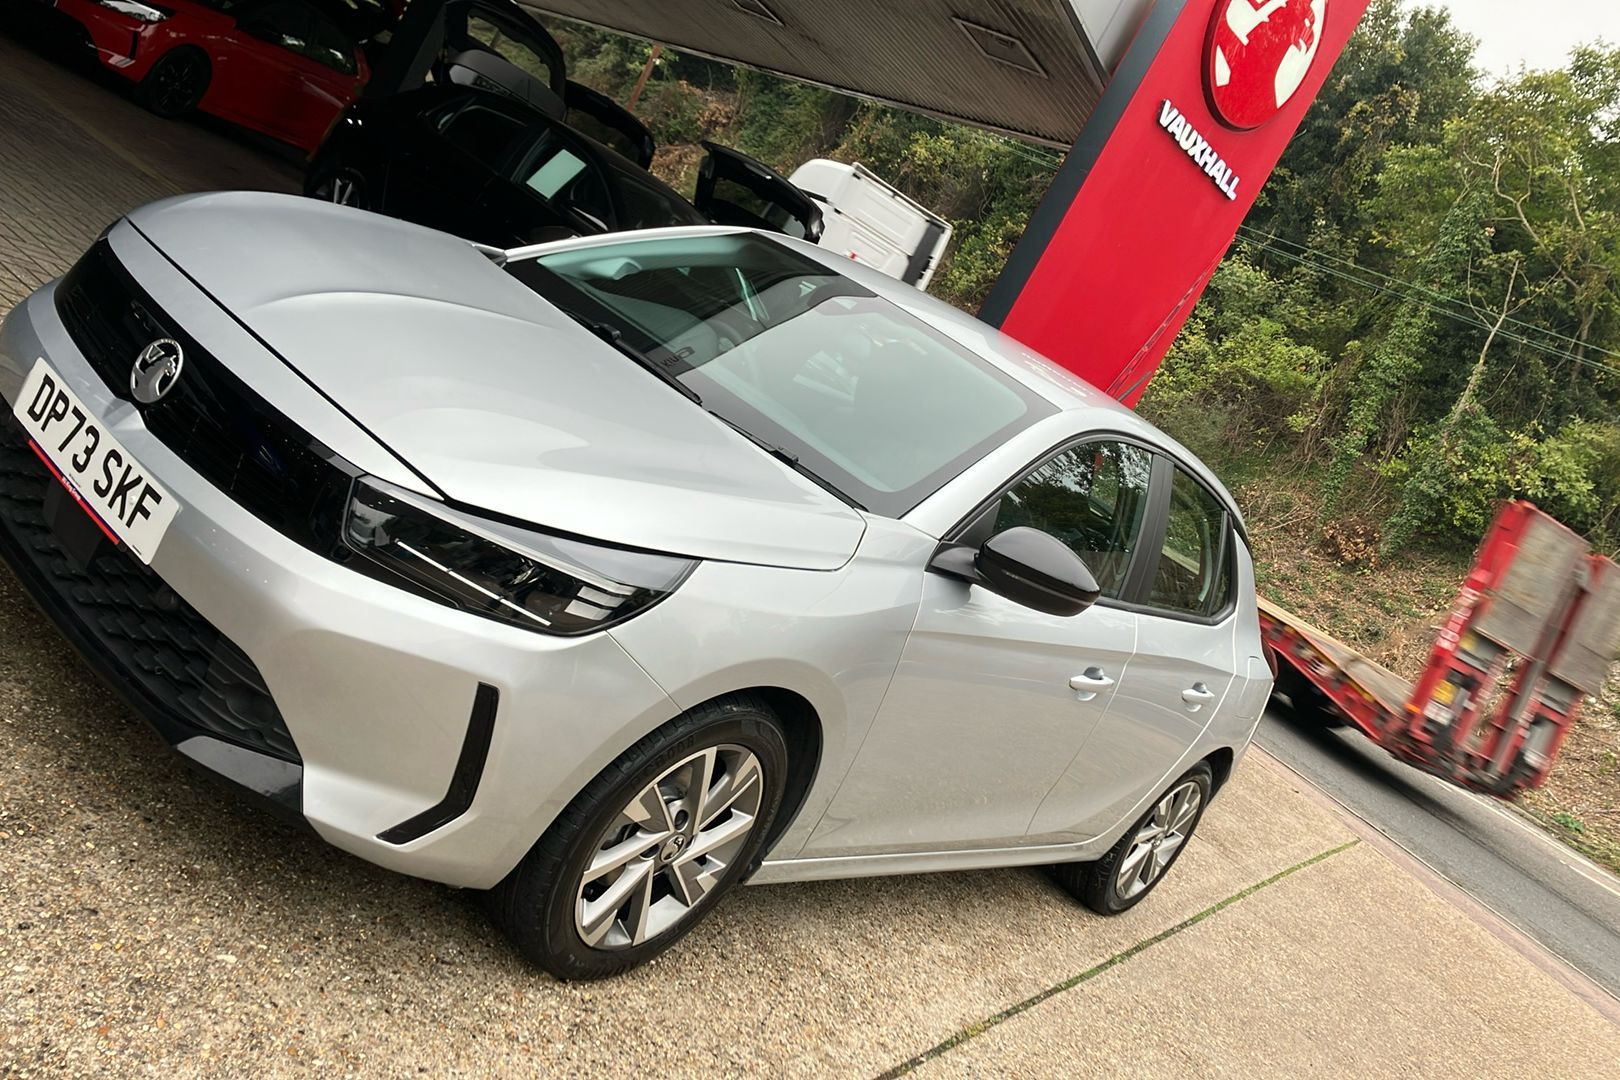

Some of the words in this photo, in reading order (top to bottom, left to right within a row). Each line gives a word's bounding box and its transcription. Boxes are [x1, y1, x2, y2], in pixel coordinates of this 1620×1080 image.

[1159, 99, 1240, 201] VAUXHALL
[27, 373, 100, 473] DP73
[93, 449, 162, 528] SKF
